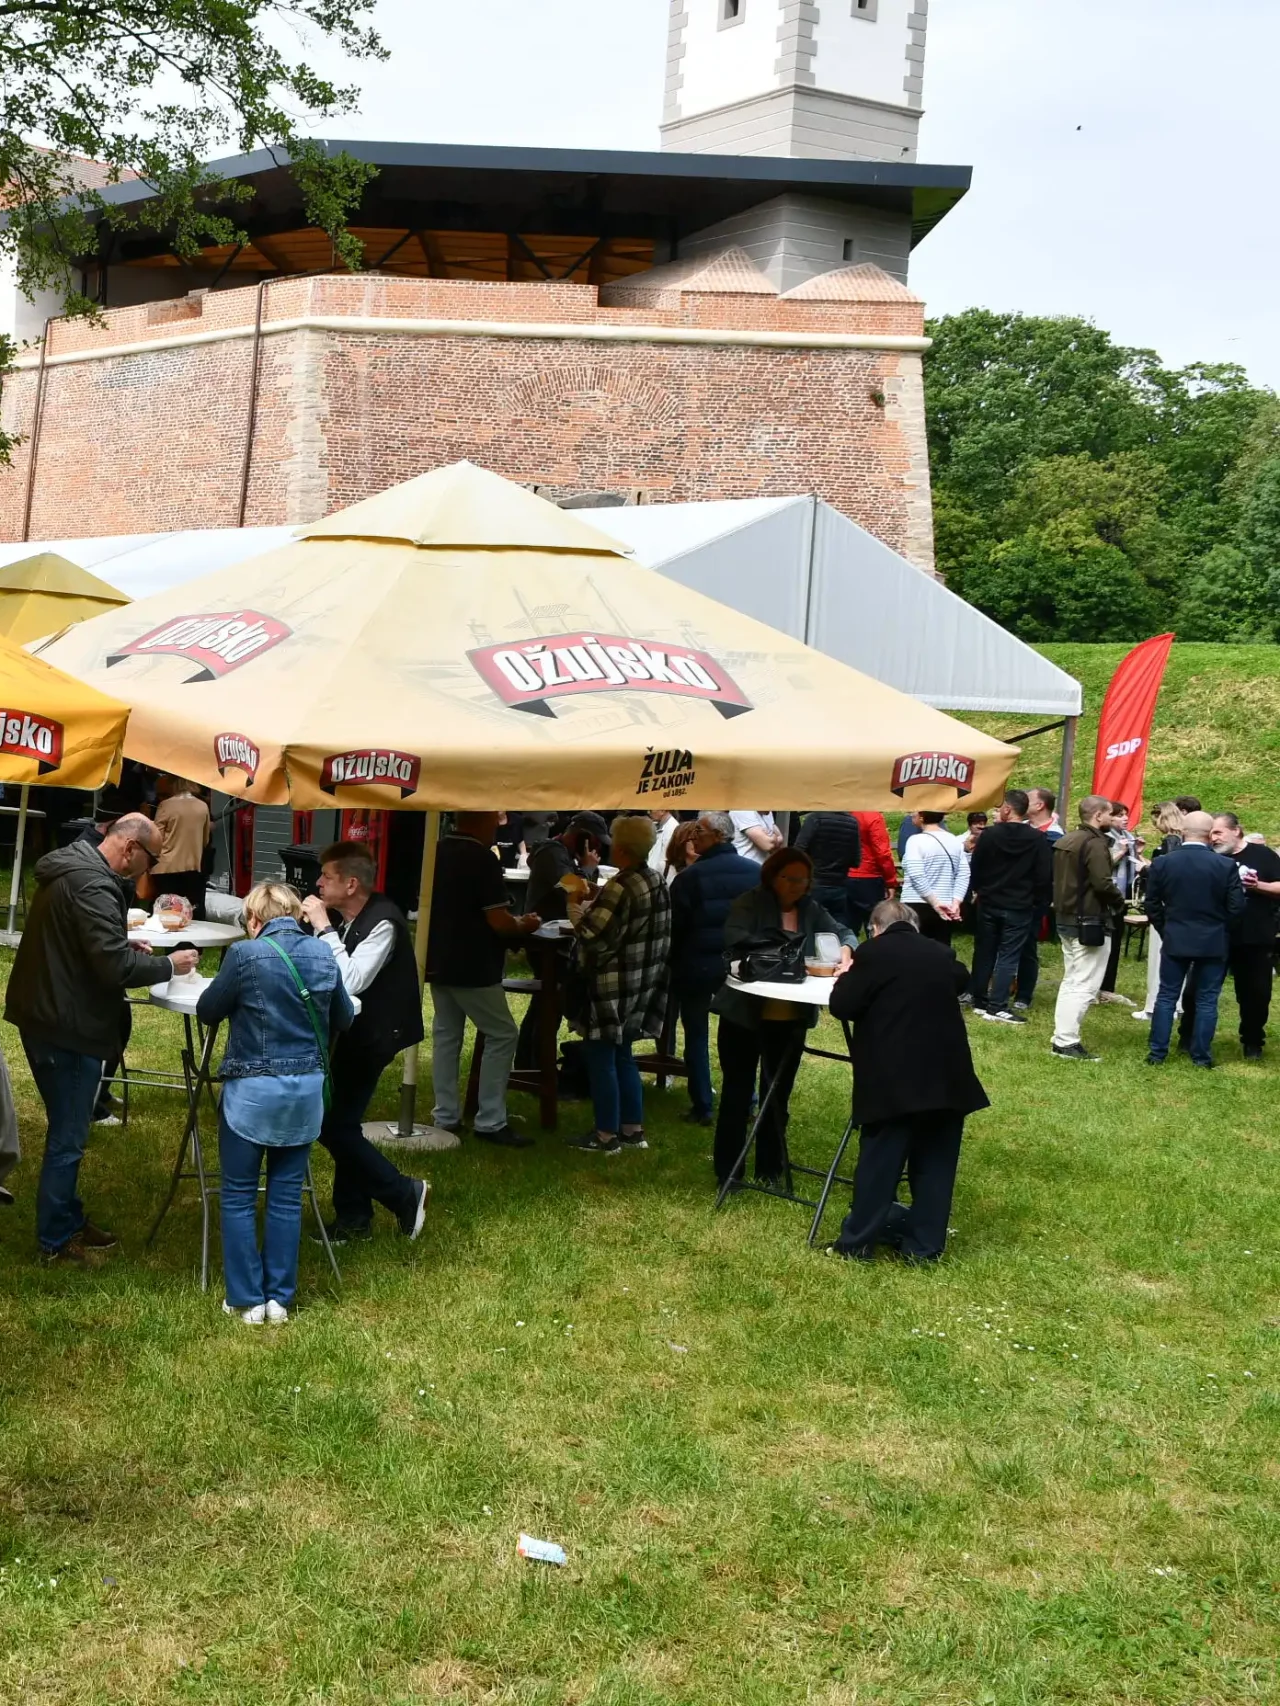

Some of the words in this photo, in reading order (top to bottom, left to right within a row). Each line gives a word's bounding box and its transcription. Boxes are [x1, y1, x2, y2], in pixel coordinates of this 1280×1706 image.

[493, 637, 720, 692] Ožujsko
[218, 736, 257, 771] Ožujsko
[641, 746, 693, 778] ŽUJA
[1105, 738, 1142, 760] SDP
[331, 752, 412, 782] Ožujsko
[899, 753, 968, 783] Ožujsko
[636, 779, 650, 794] JE
[652, 772, 695, 791] ZAKON!
